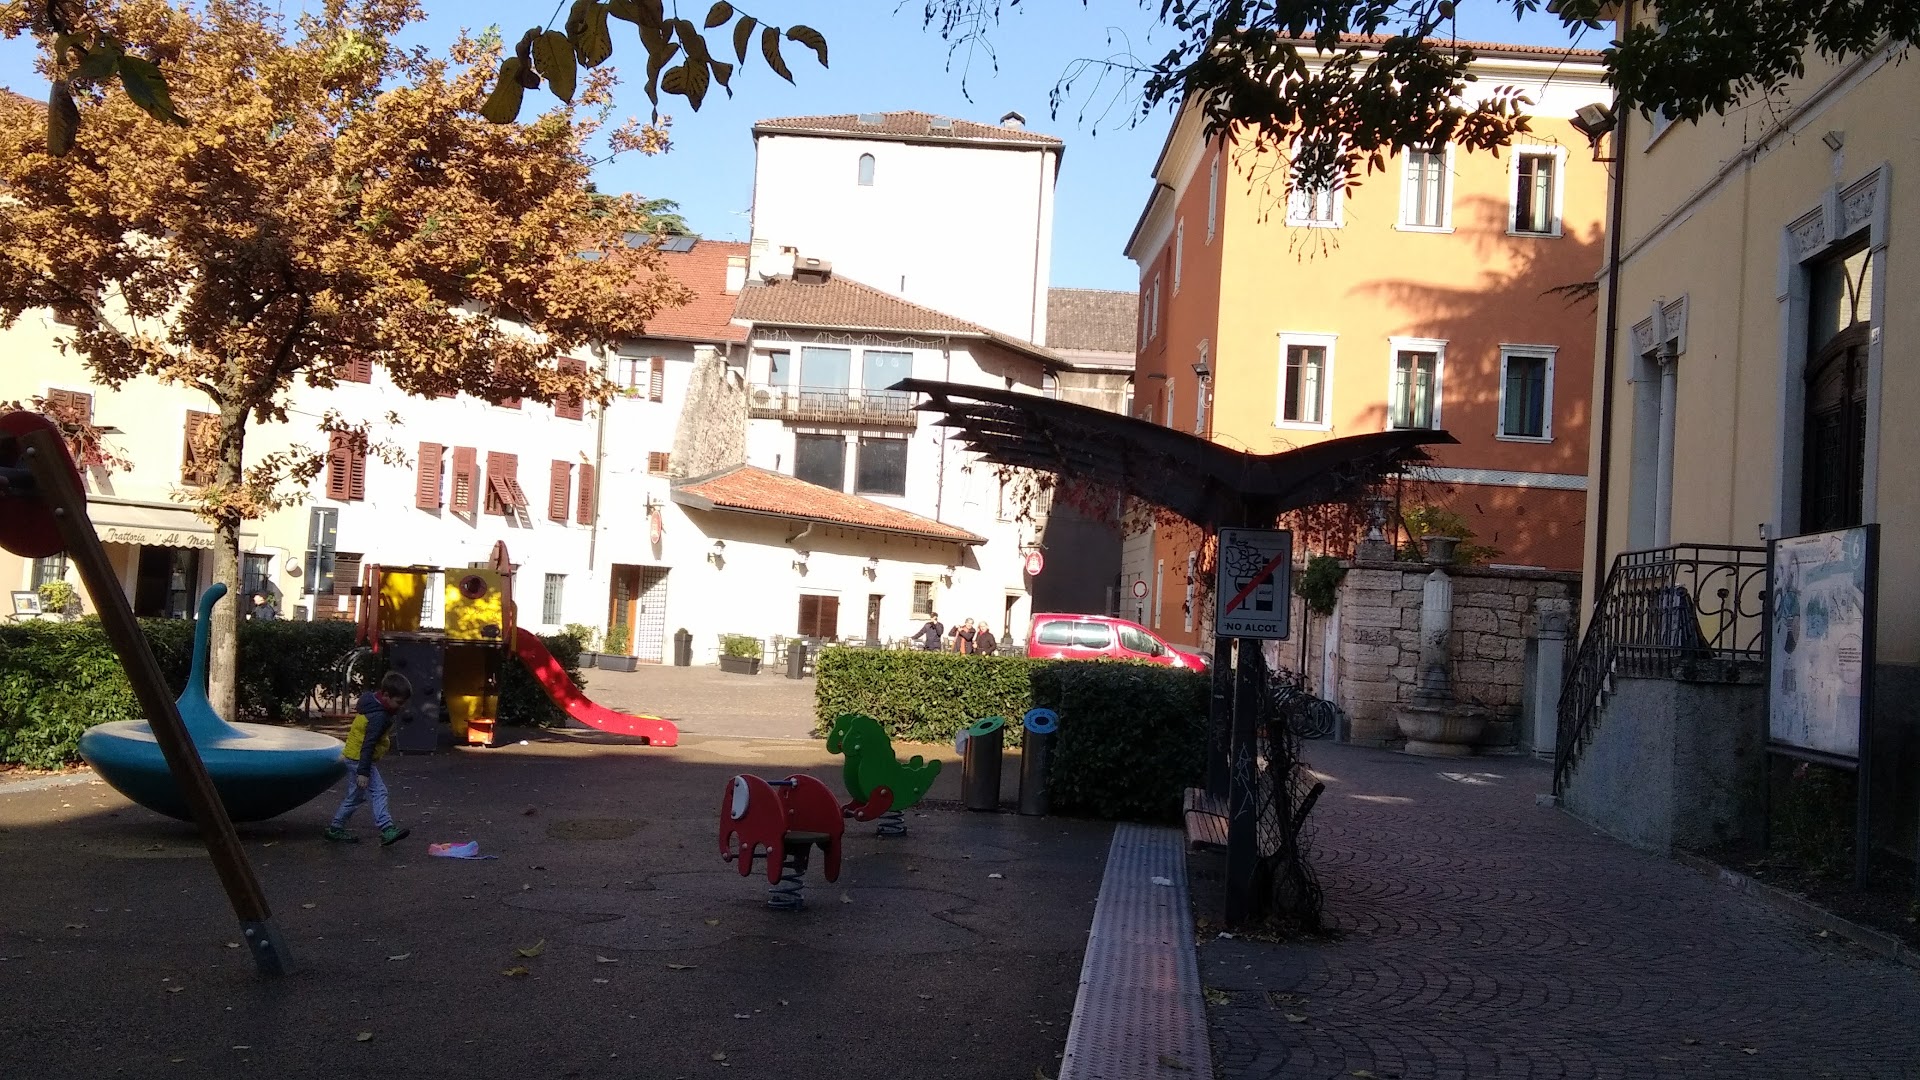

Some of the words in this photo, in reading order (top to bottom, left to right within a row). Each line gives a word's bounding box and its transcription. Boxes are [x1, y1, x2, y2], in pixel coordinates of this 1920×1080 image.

[108, 528, 145, 543] Trattoria
[187, 534, 215, 546] Merc
[1227, 622, 1242, 631] NO
